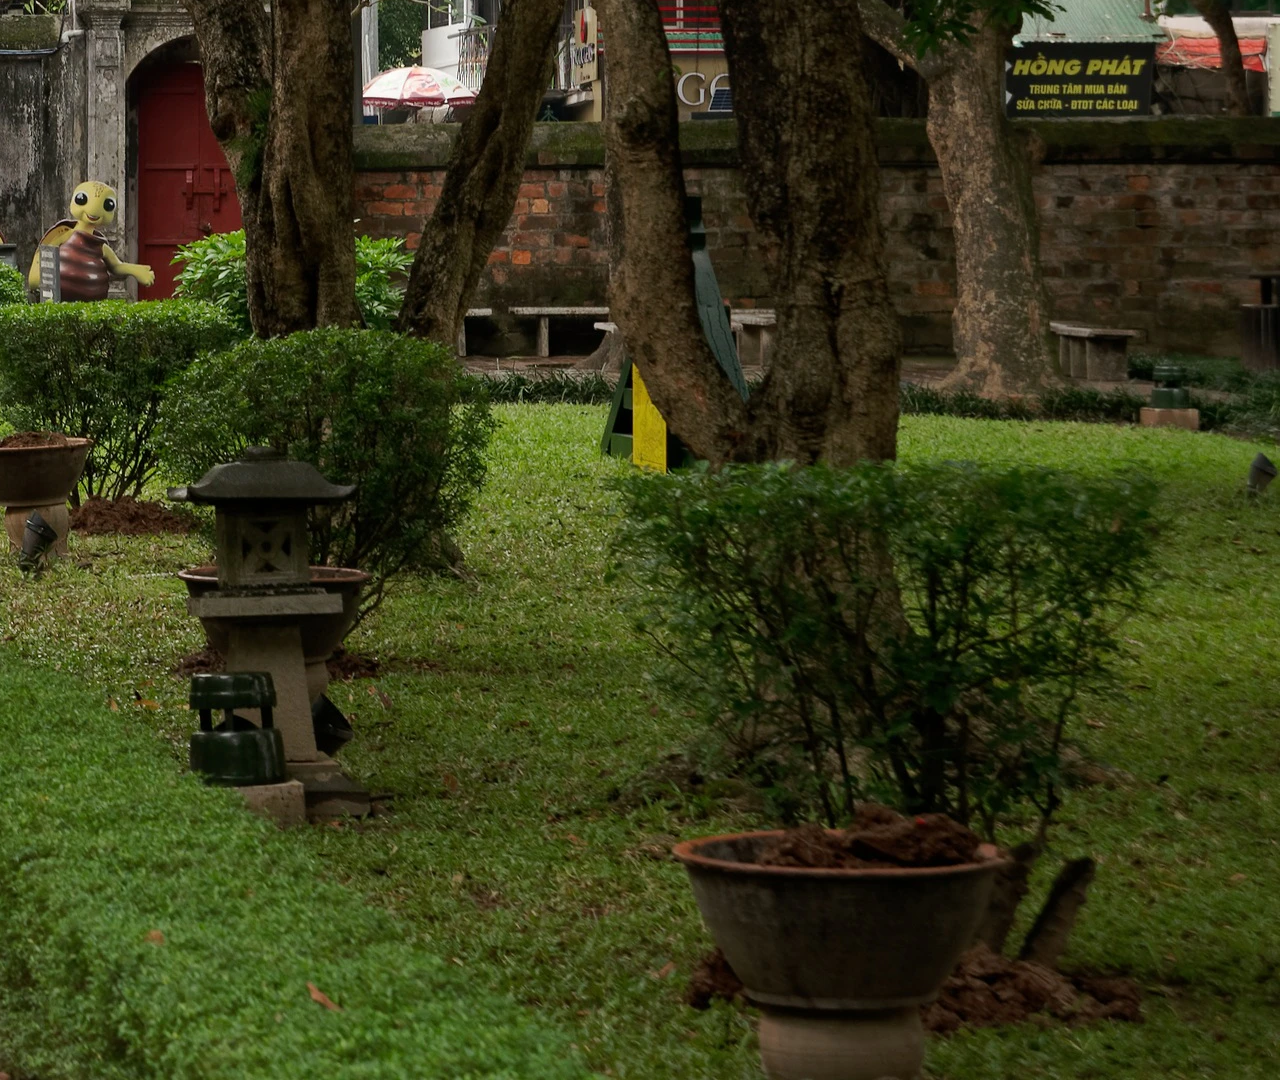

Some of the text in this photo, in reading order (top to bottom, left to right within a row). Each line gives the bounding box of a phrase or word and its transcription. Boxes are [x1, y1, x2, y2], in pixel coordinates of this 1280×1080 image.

[1013, 52, 1146, 75] HỒNG PHÁT
[1029, 82, 1127, 94] TRUNG TÂM MUA BÁN
[1095, 98, 1115, 110] CÁC
[1117, 100, 1138, 112] LOẠI
